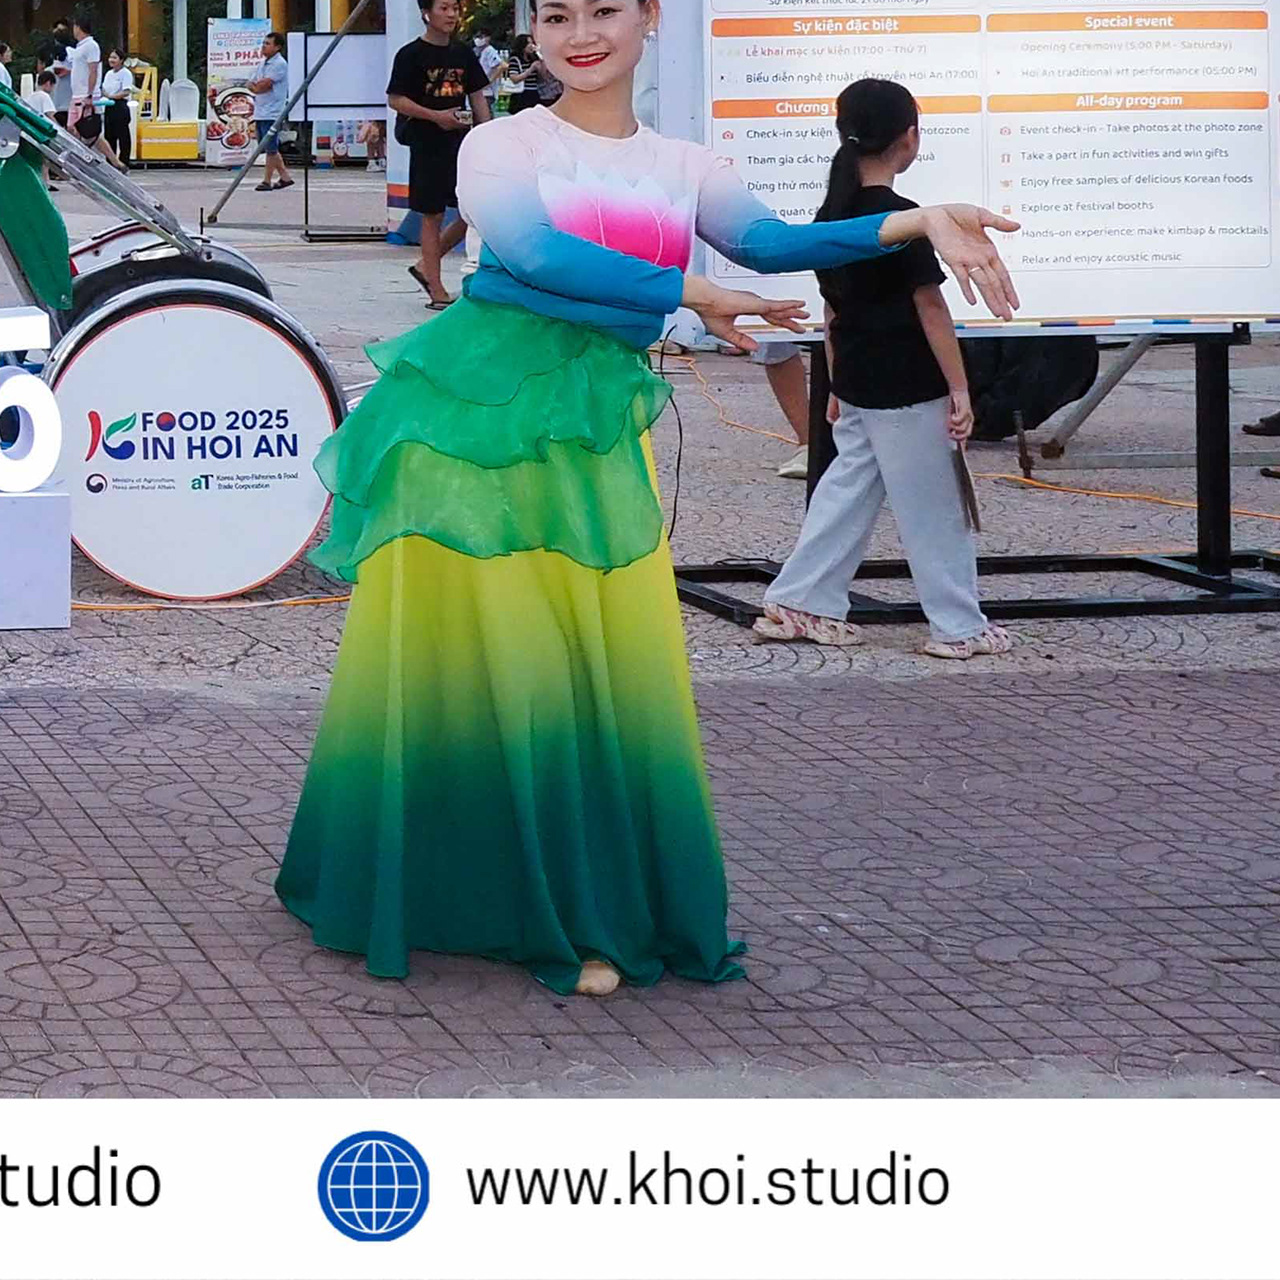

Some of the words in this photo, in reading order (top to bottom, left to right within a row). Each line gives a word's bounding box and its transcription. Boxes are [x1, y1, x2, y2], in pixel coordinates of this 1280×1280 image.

[793, 21, 812, 35] Sự
[814, 19, 843, 34] kiện
[845, 20, 870, 34] đặc
[872, 18, 900, 32] biệt
[1085, 16, 1133, 29] Special
[1135, 17, 1174, 27] event
[1076, 95, 1125, 109] All-day
[1126, 94, 1183, 108] program
[776, 102, 829, 117] Chương
[746, 129, 793, 141] Check-in
[795, 129, 809, 140] sự
[811, 127, 833, 140] kiện
[919, 126, 970, 135] hotozone
[1020, 126, 1050, 135] Event
[1052, 124, 1097, 134] check-in
[1106, 124, 1130, 133] Take
[1132, 123, 1169, 135] photos
[1170, 124, 1182, 132] at
[1184, 123, 1202, 132] the
[1204, 123, 1235, 134] photo
[1237, 124, 1263, 132] zone
[747, 155, 776, 165] Tham
[778, 155, 794, 167] gia
[797, 154, 817, 165] các
[1021, 151, 1044, 161] Take
[1055, 151, 1077, 163] part
[1080, 150, 1089, 159] in
[1091, 150, 1110, 159] fun
[1112, 149, 1160, 159] activities
[1162, 148, 1182, 158] and
[1183, 149, 1203, 158] win
[1205, 148, 1229, 160] gifts
[1021, 177, 1049, 189] Enjoy
[1052, 176, 1074, 186] free
[1076, 176, 1119, 187] samples
[1121, 175, 1133, 184] of
[1135, 174, 1182, 184] delicious
[1184, 174, 1221, 184] Korean
[1223, 174, 1253, 183] foods
[1021, 203, 1060, 214] Explore
[1063, 203, 1073, 212] at
[1076, 201, 1115, 211] festival
[1117, 200, 1154, 210] booths
[1021, 228, 1072, 238] Hands-on
[1137, 226, 1165, 235] make
[1168, 225, 1205, 237] kimbap
[1207, 226, 1216, 235] &
[1218, 224, 1268, 235] mocktails
[1022, 255, 1050, 264] Relax
[1052, 254, 1072, 264] and
[1074, 254, 1103, 265] enjoy
[1105, 252, 1149, 262] acoustic
[1151, 251, 1182, 261] music
[142, 411, 216, 432] FOOD
[225, 409, 290, 431] 2025
[142, 436, 175, 460] IN
[187, 434, 241, 460] HOI
[253, 433, 299, 458] AN
